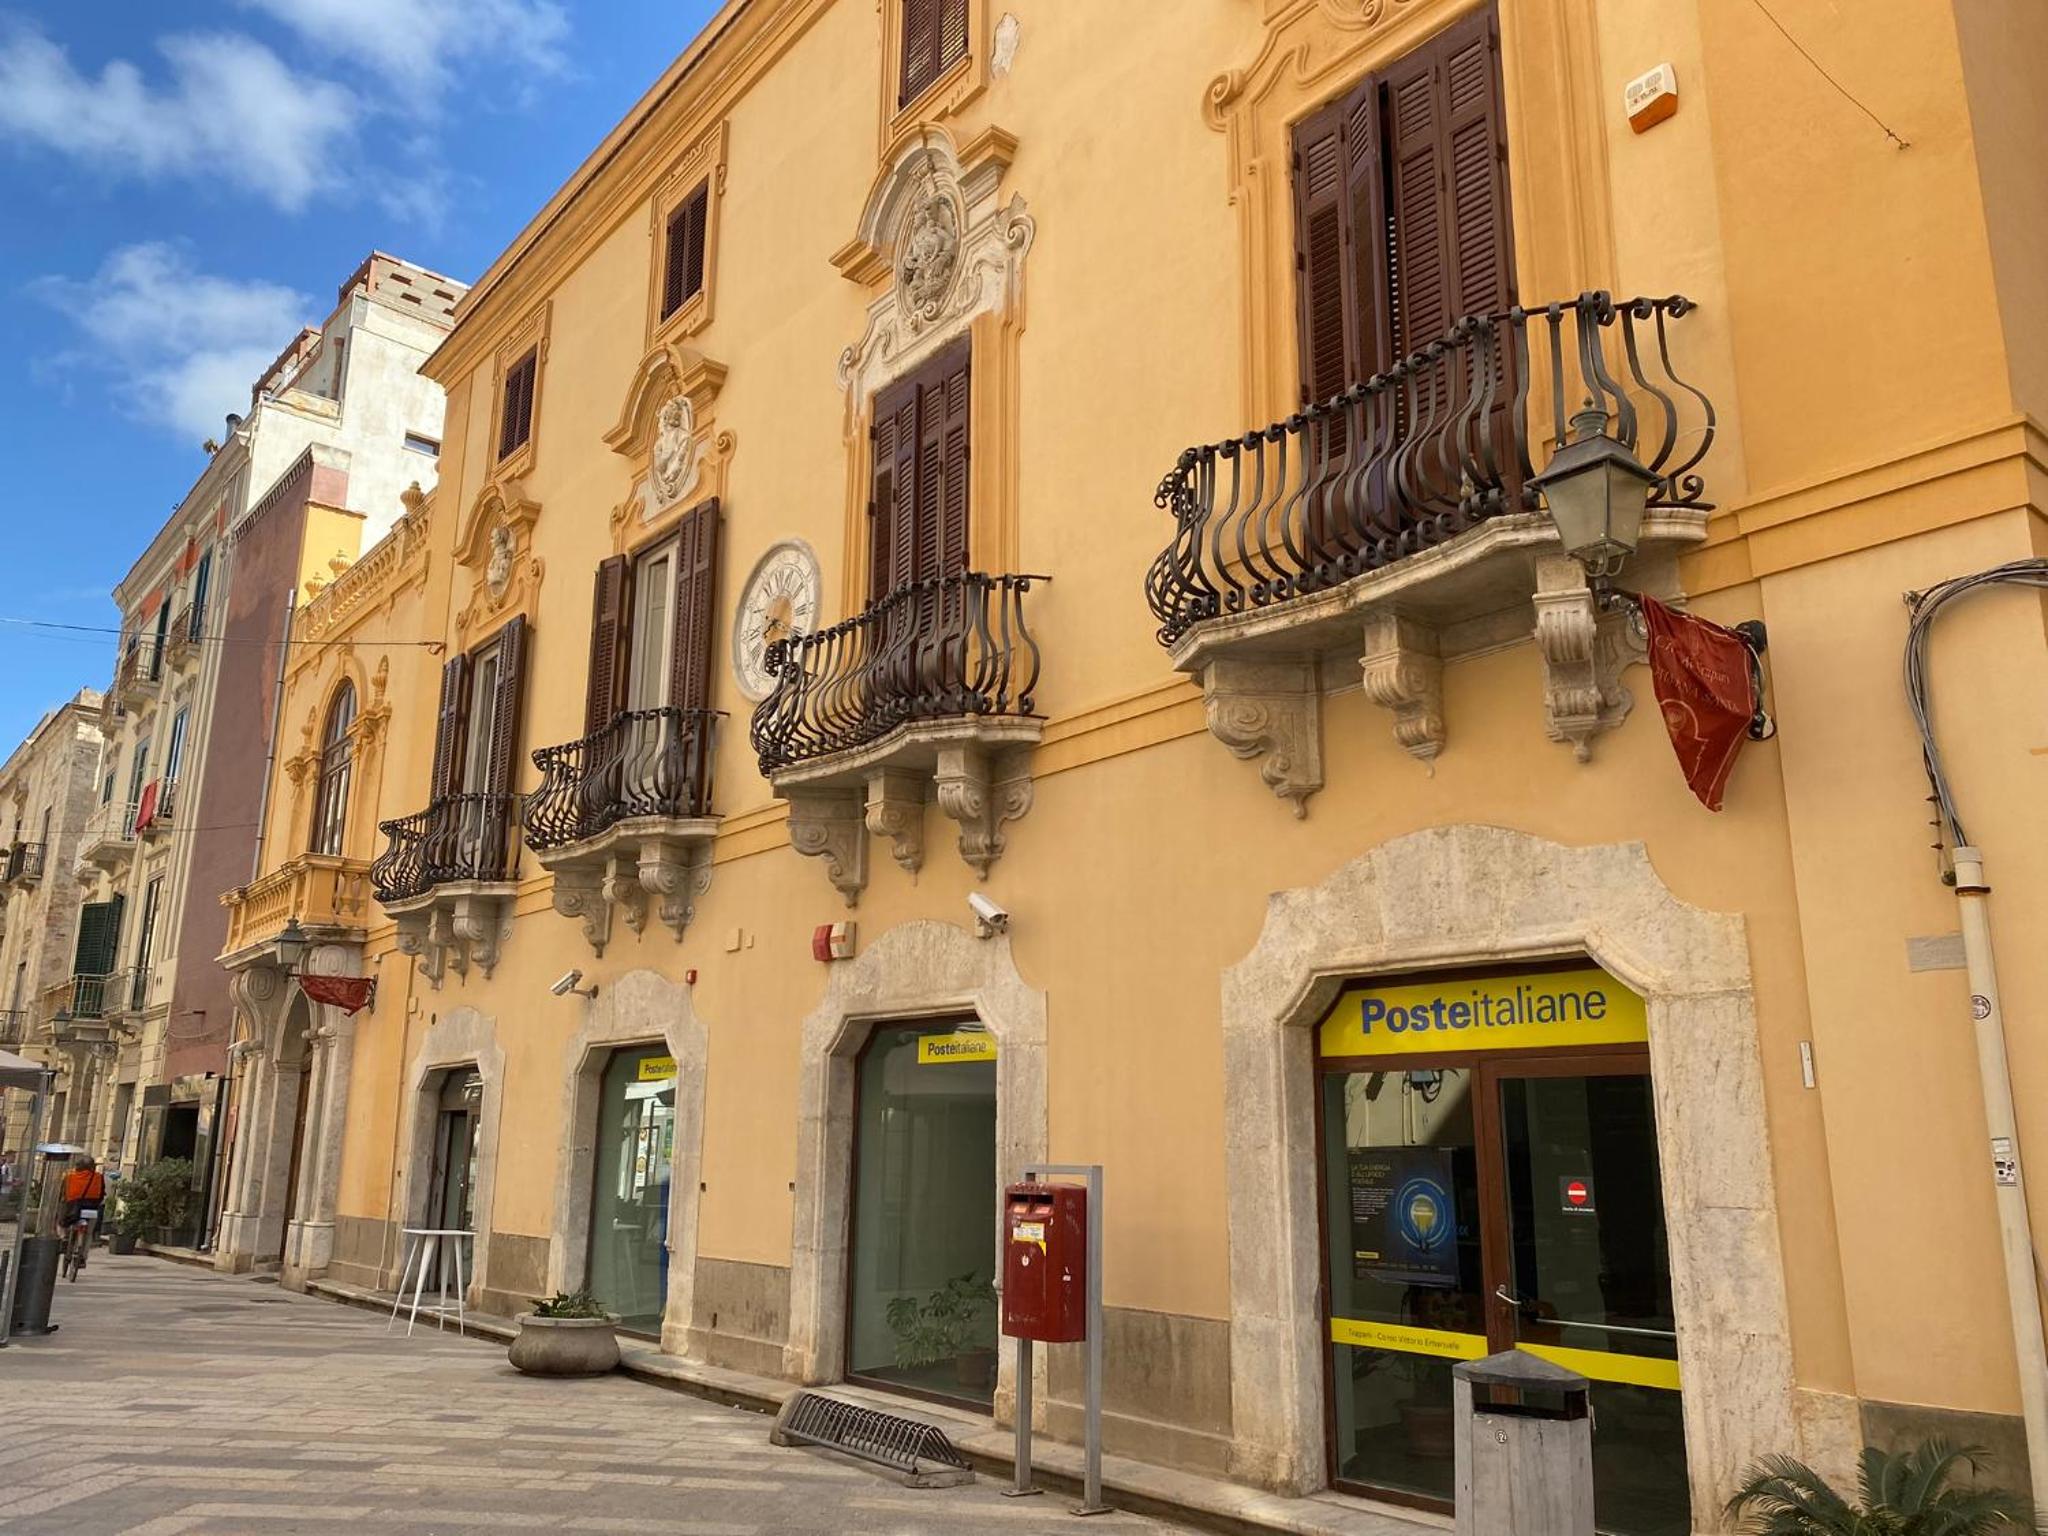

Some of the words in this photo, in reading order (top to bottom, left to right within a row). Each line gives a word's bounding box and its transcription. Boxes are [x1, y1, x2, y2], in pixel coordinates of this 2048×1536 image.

[1361, 985, 1606, 1034] Posteitaliane
[927, 1041, 987, 1056] Posteitaliane
[1377, 1331, 1398, 1343] Corso
